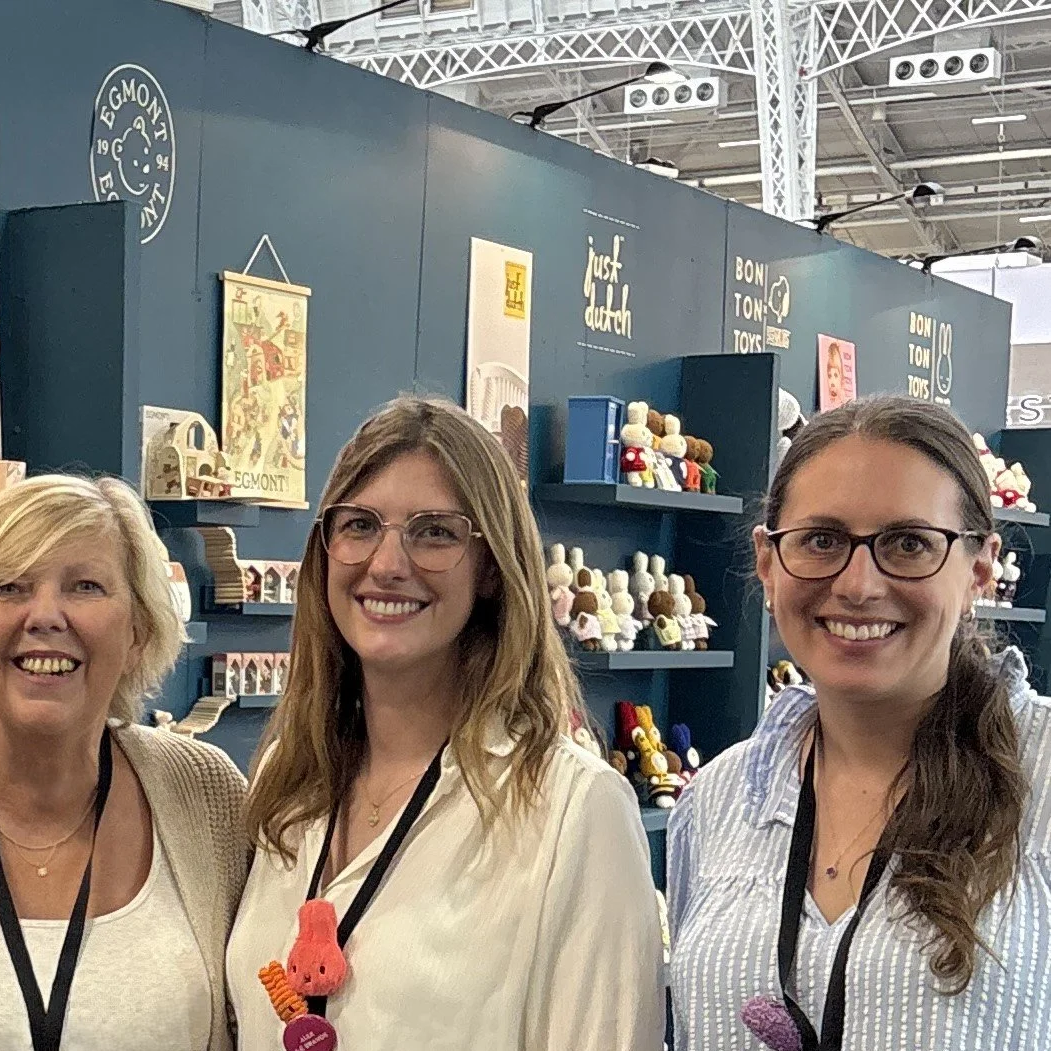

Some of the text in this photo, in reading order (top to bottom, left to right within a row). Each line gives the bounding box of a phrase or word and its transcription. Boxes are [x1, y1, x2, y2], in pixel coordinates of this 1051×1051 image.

[100, 78, 168, 142] EGMONT
[97, 139, 109, 155] 19
[156, 154, 169, 171] 94
[583, 235, 623, 298] just
[735, 256, 764, 286] BON
[584, 282, 632, 340] dutch
[734, 293, 763, 322] TON
[909, 312, 932, 338] BON
[733, 330, 762, 353] TOYS
[908, 343, 931, 369] TON
[907, 374, 930, 400] TOYS
[234, 471, 285, 493] EGMONT
